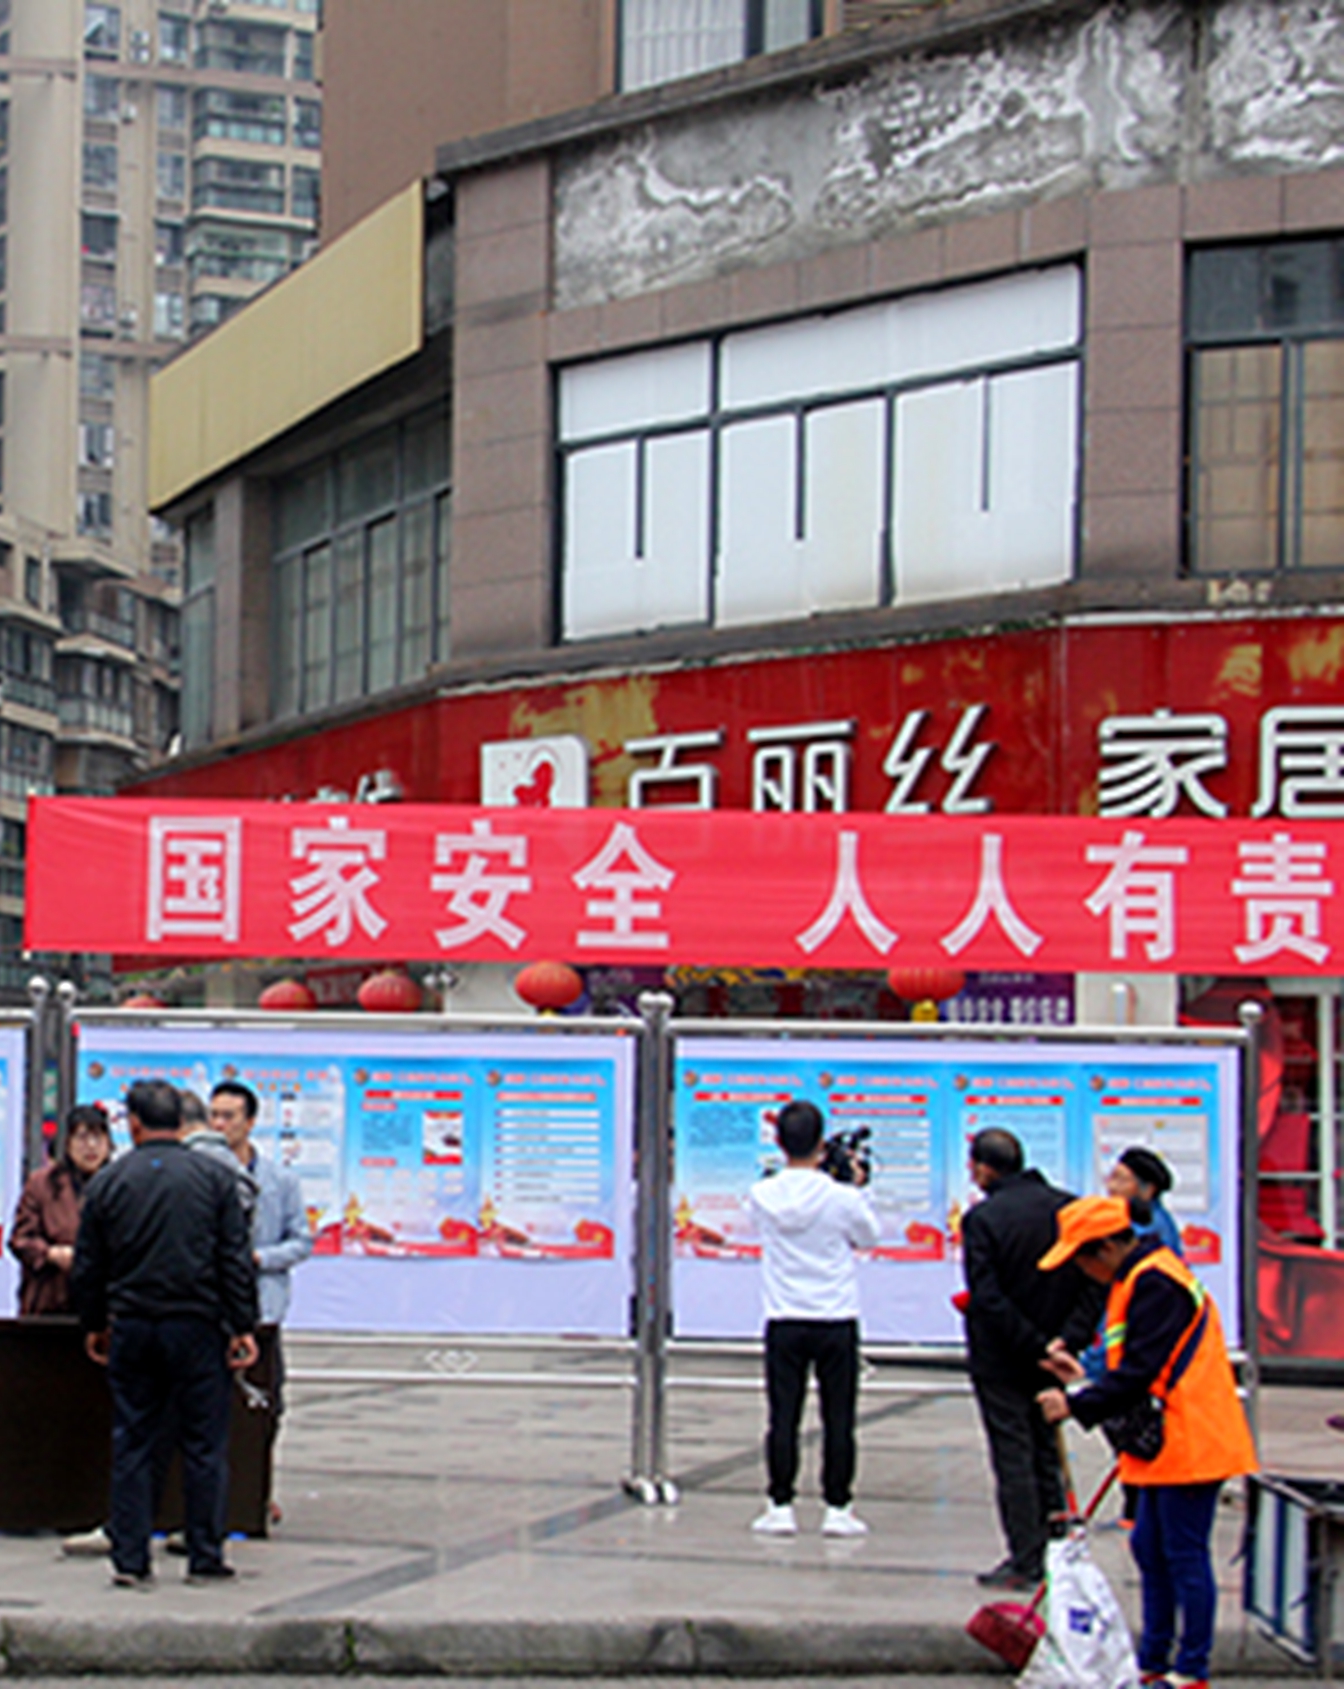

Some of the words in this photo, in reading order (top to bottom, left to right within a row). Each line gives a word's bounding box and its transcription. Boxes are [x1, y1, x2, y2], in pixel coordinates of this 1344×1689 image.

[146, 815, 675, 950] 国家安全
[795, 830, 1333, 964] 人人有责
